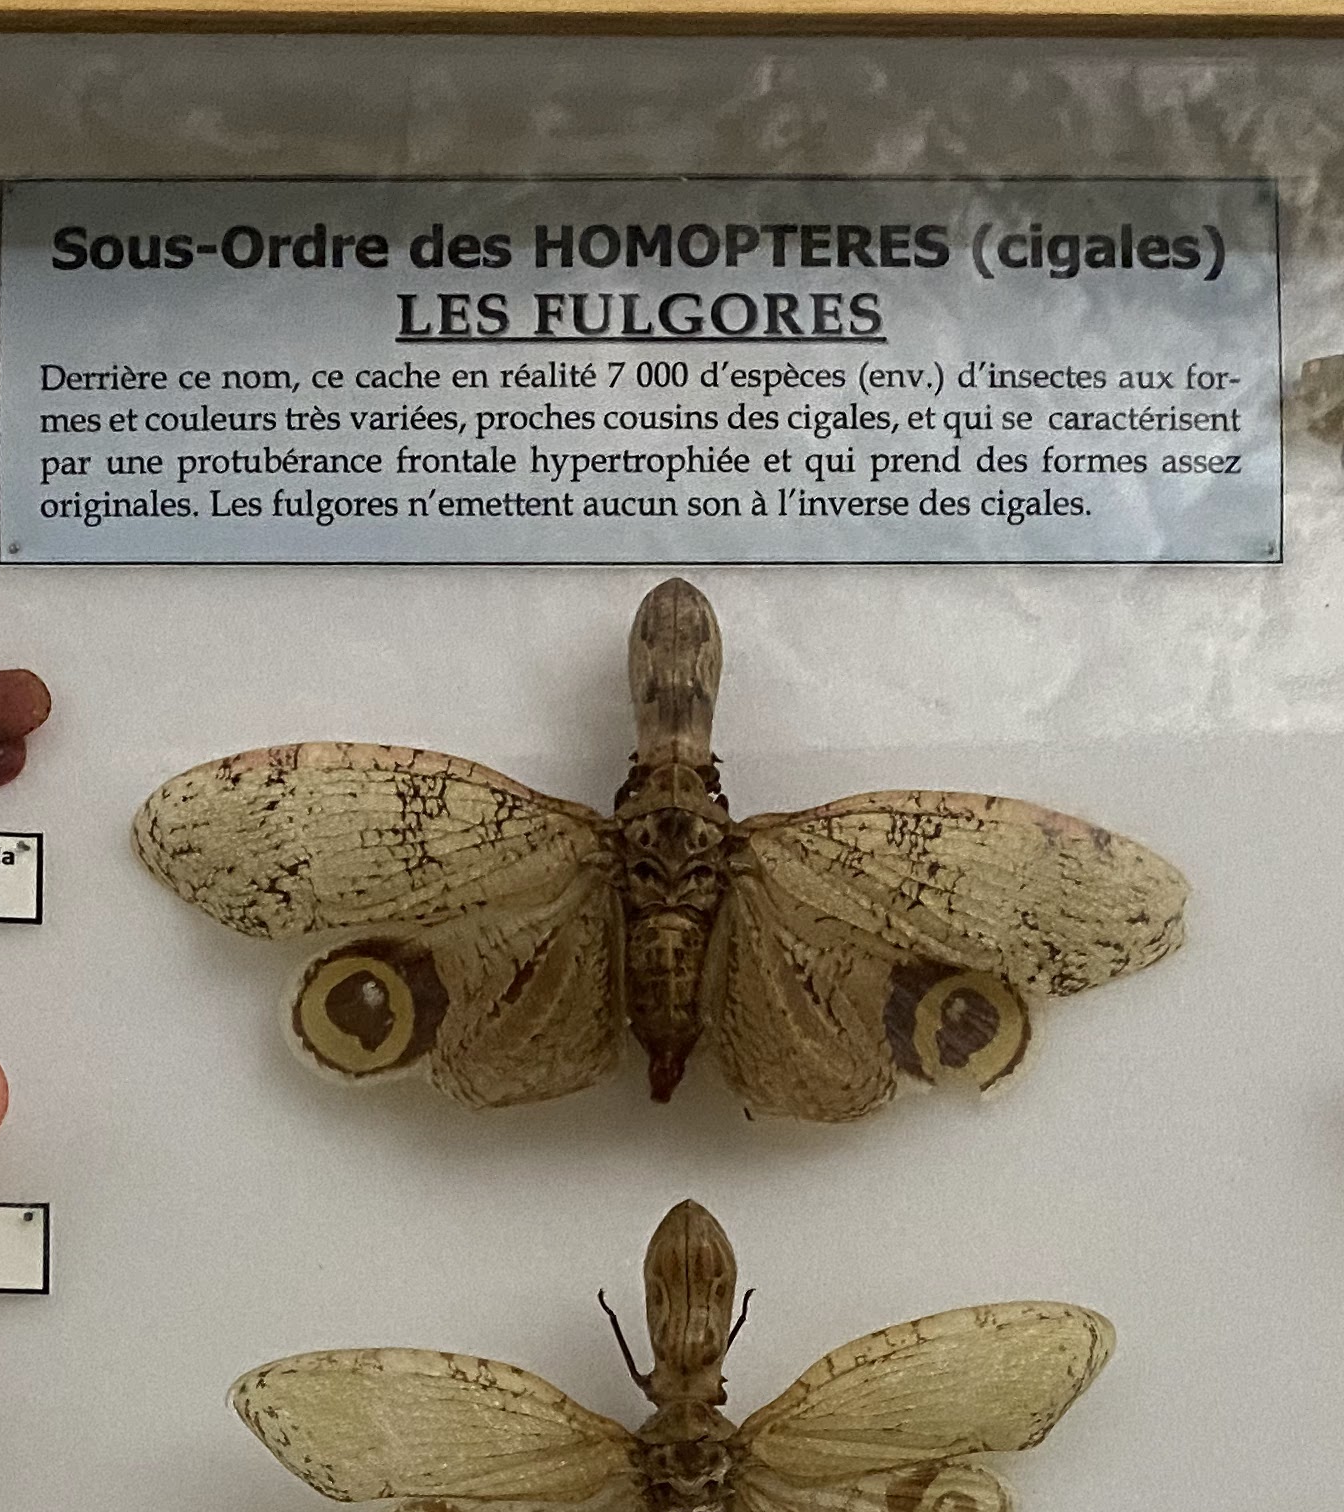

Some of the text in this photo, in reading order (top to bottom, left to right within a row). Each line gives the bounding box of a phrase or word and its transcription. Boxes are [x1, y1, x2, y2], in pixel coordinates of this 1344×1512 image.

[52, 222, 1225, 281] Sous-Ordre des HOMOPTERES (cigales)
[397, 292, 885, 336] LES FULGORES
[40, 361, 1242, 400] Derrière ce nom, ce cache en réalité 7 000 d'espèces (env.) d'insectes aux for-
[39, 403, 1242, 442] mes et couleurs très variées, proches cousins des cigales, et qui se caractérisent
[40, 444, 1243, 485] par une protubérance frontale hypertrophiée et qui prend des formes assez
[40, 486, 1093, 528] originales. Les fulgores n'emettent aucun son à l'inverse des cigales.
